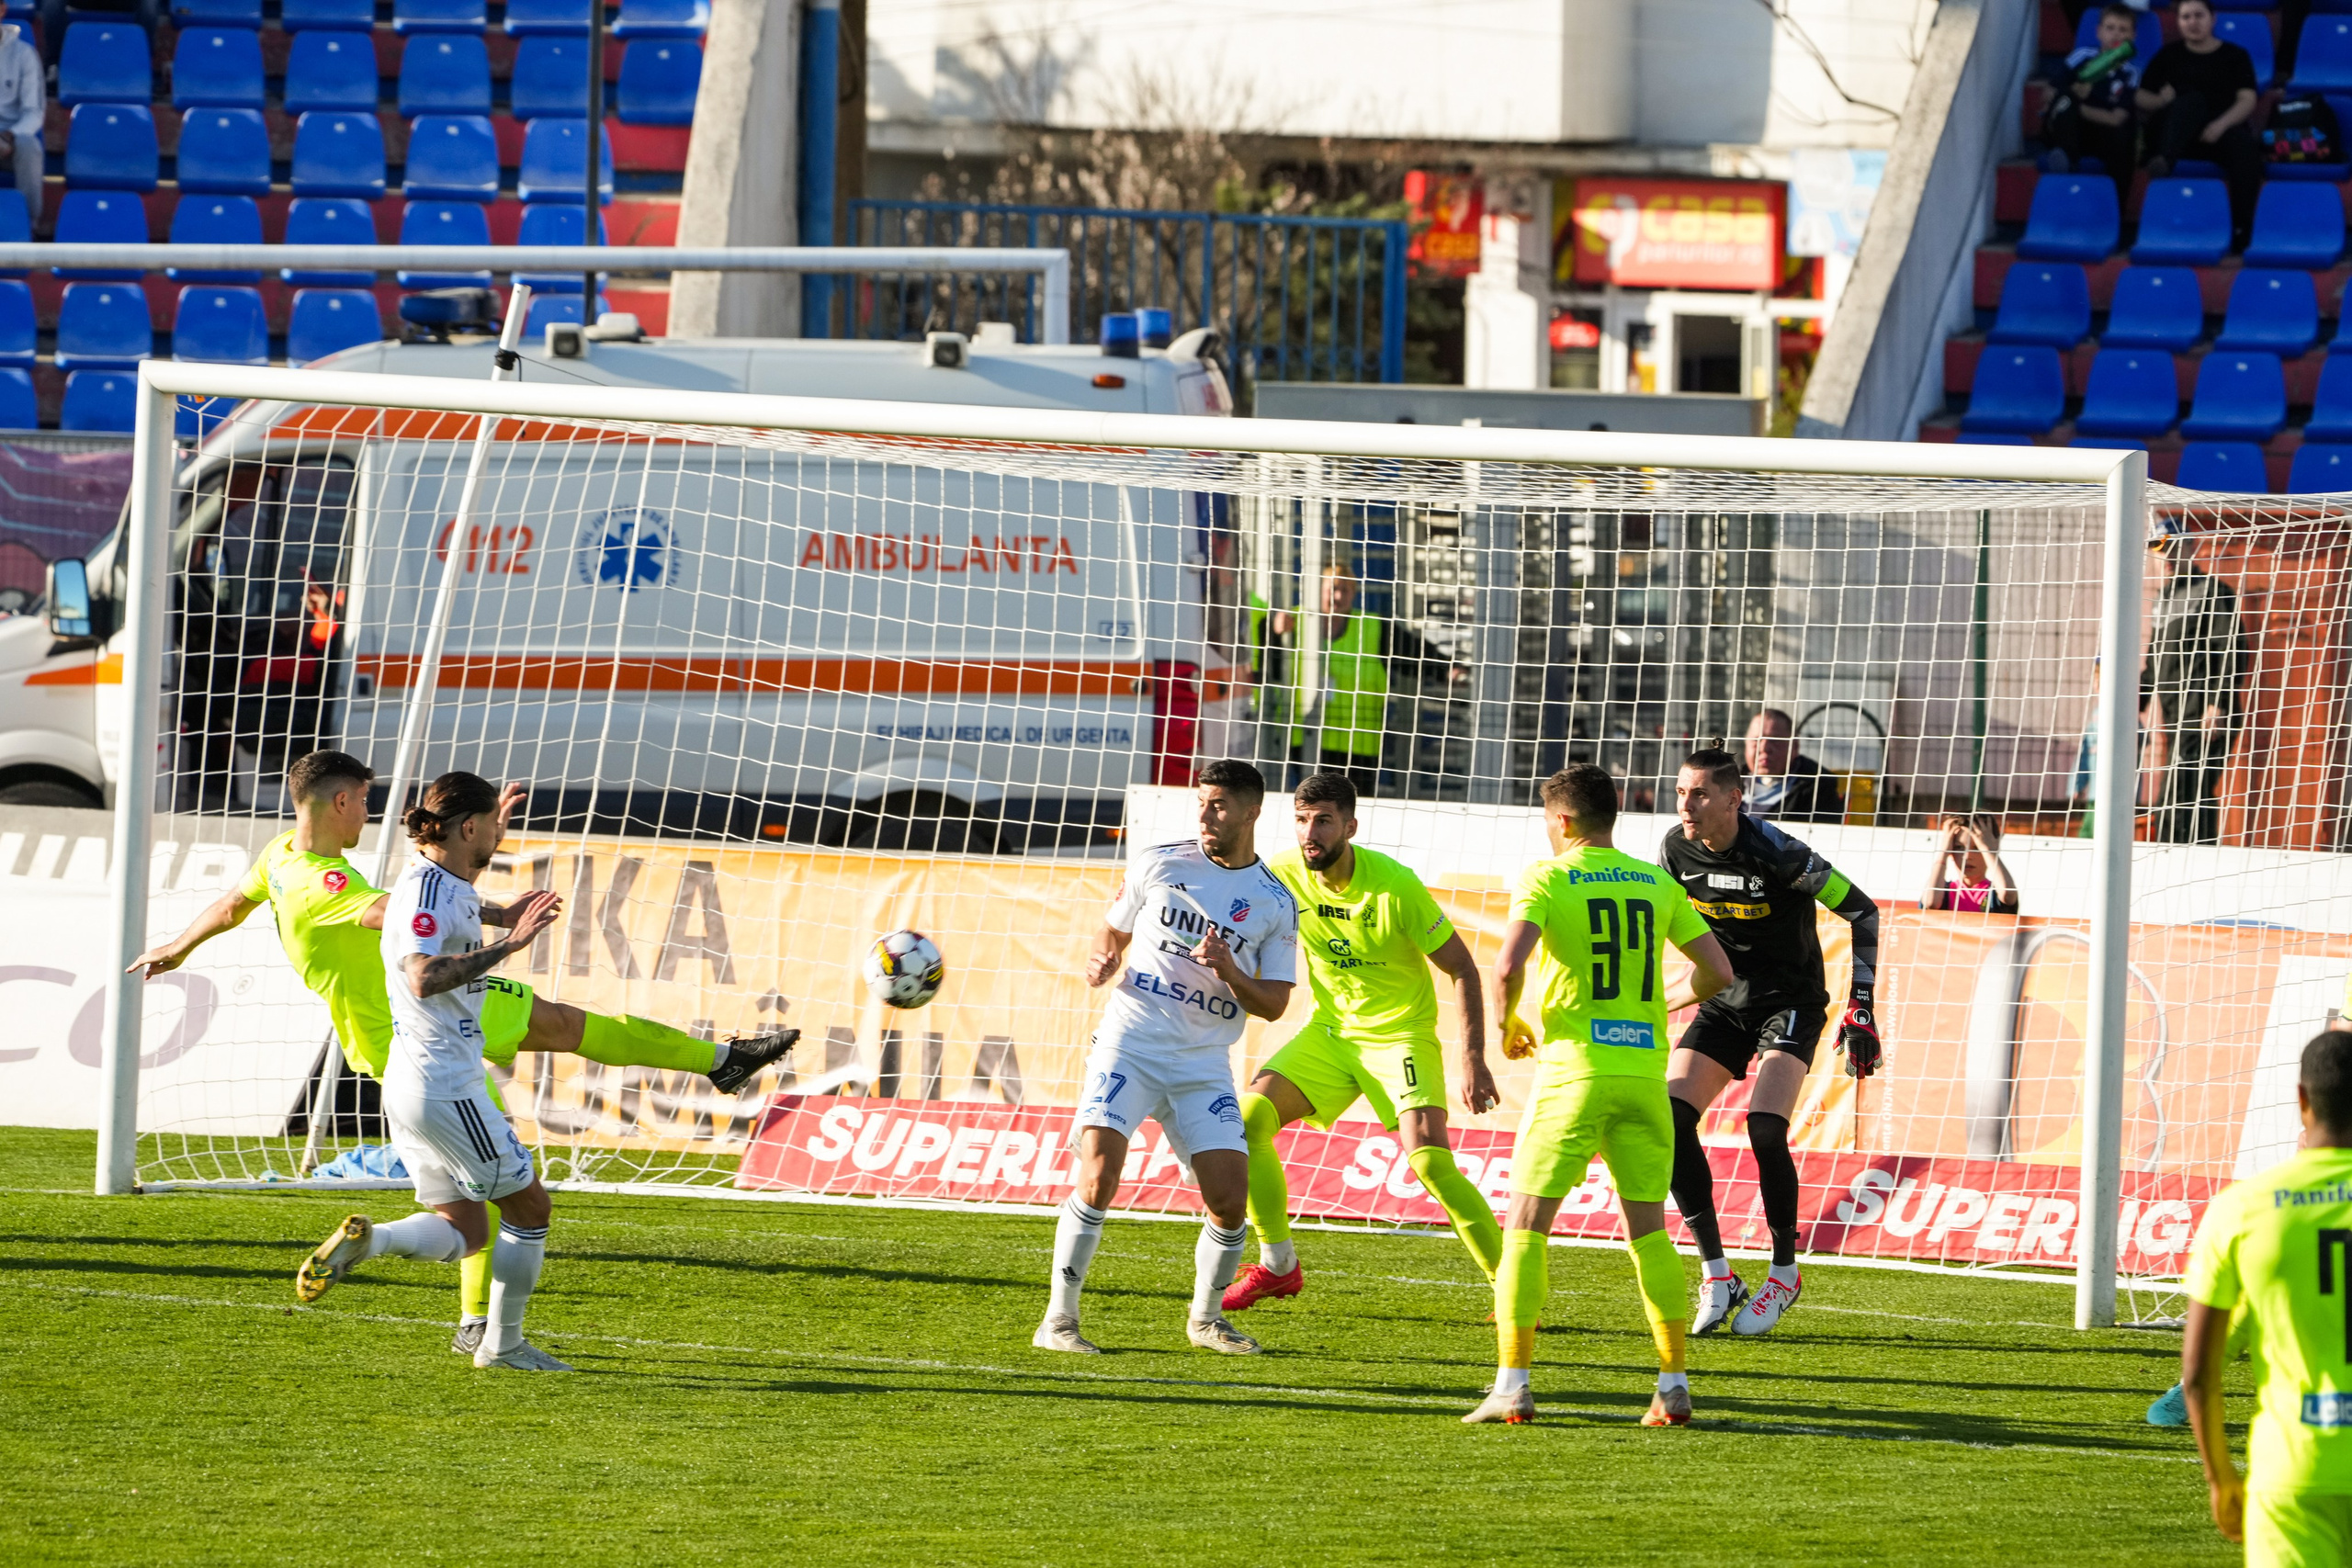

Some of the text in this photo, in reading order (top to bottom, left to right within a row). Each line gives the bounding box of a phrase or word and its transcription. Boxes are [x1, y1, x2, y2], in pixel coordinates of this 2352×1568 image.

[1642, 194, 1768, 244] casa
[466, 525, 534, 574] 112
[801, 533, 1078, 574] AMBULANTA
[876, 726, 1131, 744] ECHIPAJ MEDICAL DE URGENTA
[1568, 867, 1657, 885] Panifcom
[1707, 873, 1745, 890] IASI
[1744, 907, 1763, 917] BET
[1587, 897, 1654, 1001] 37
[1134, 972, 1238, 1020] ELSACO
[1594, 1023, 1651, 1044] Leier
[1403, 1056, 1417, 1087] 6
[1090, 1072, 1127, 1104] 27
[1102, 1110, 1127, 1125] Vestra
[807, 1104, 1194, 1187] SUPERLGA
[1836, 1168, 2197, 1256] SUPERIG
